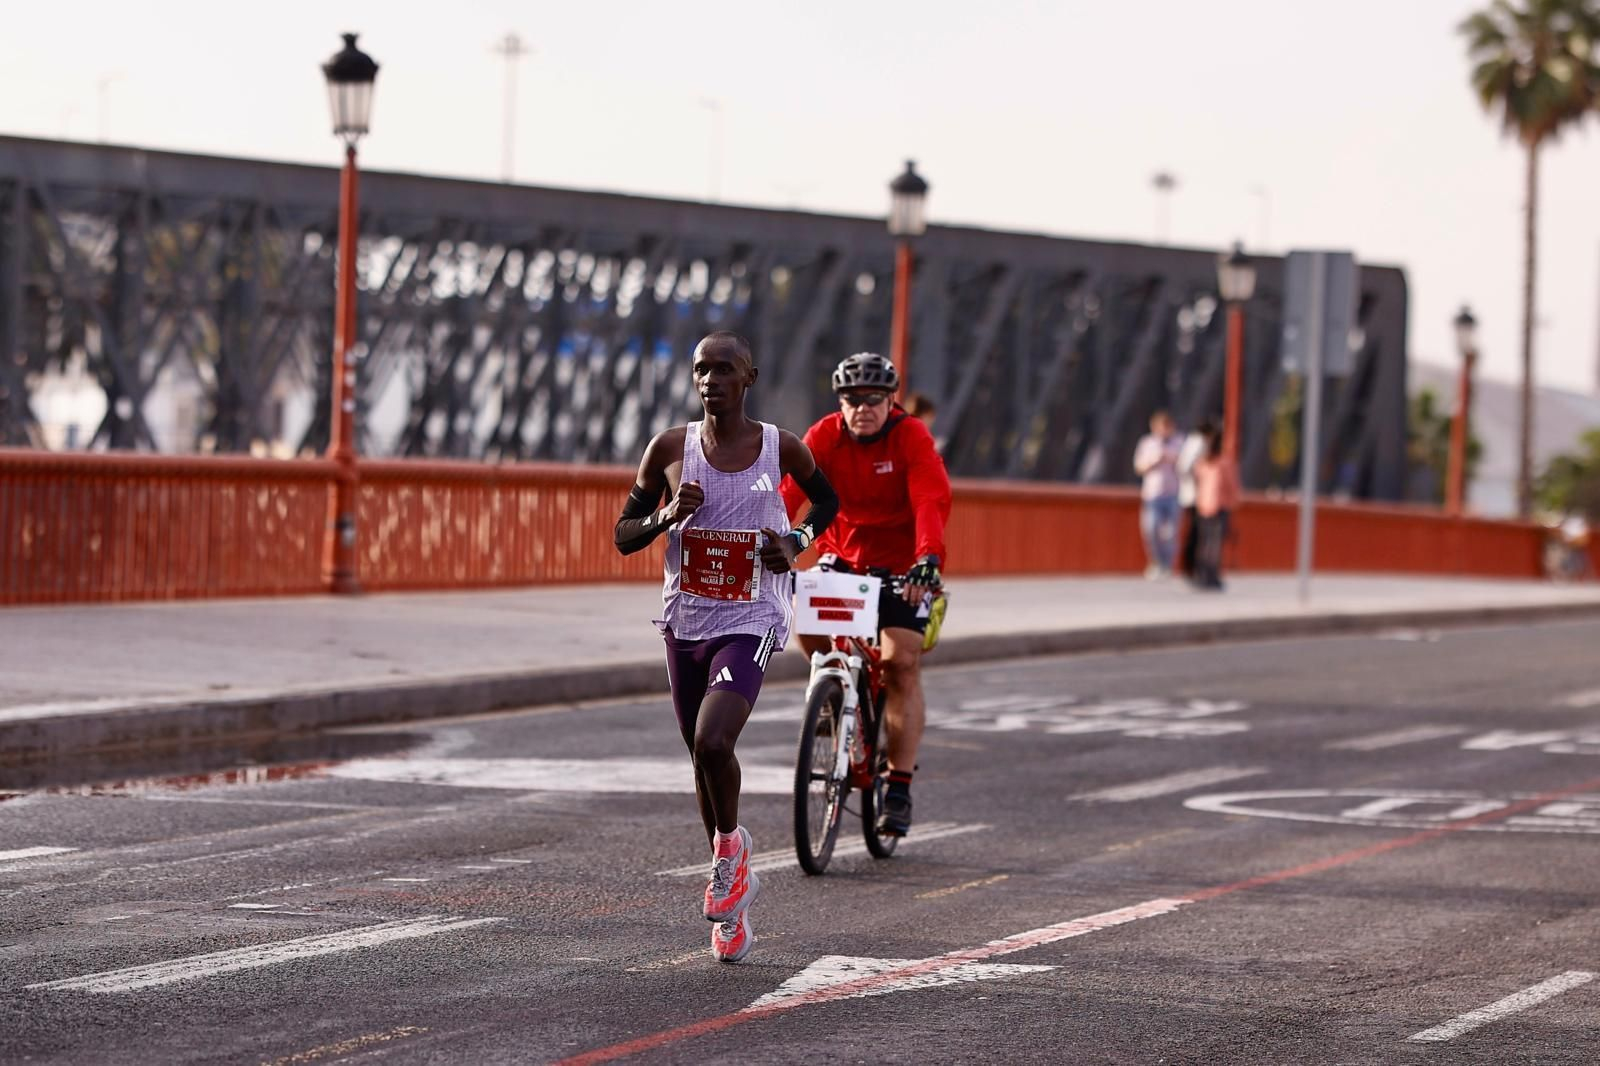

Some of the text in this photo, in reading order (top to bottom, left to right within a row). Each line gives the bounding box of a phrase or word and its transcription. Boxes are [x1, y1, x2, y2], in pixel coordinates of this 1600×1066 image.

[702, 531, 751, 543] GENERALI
[706, 548, 729, 557] MIKE
[711, 561, 723, 570] 14
